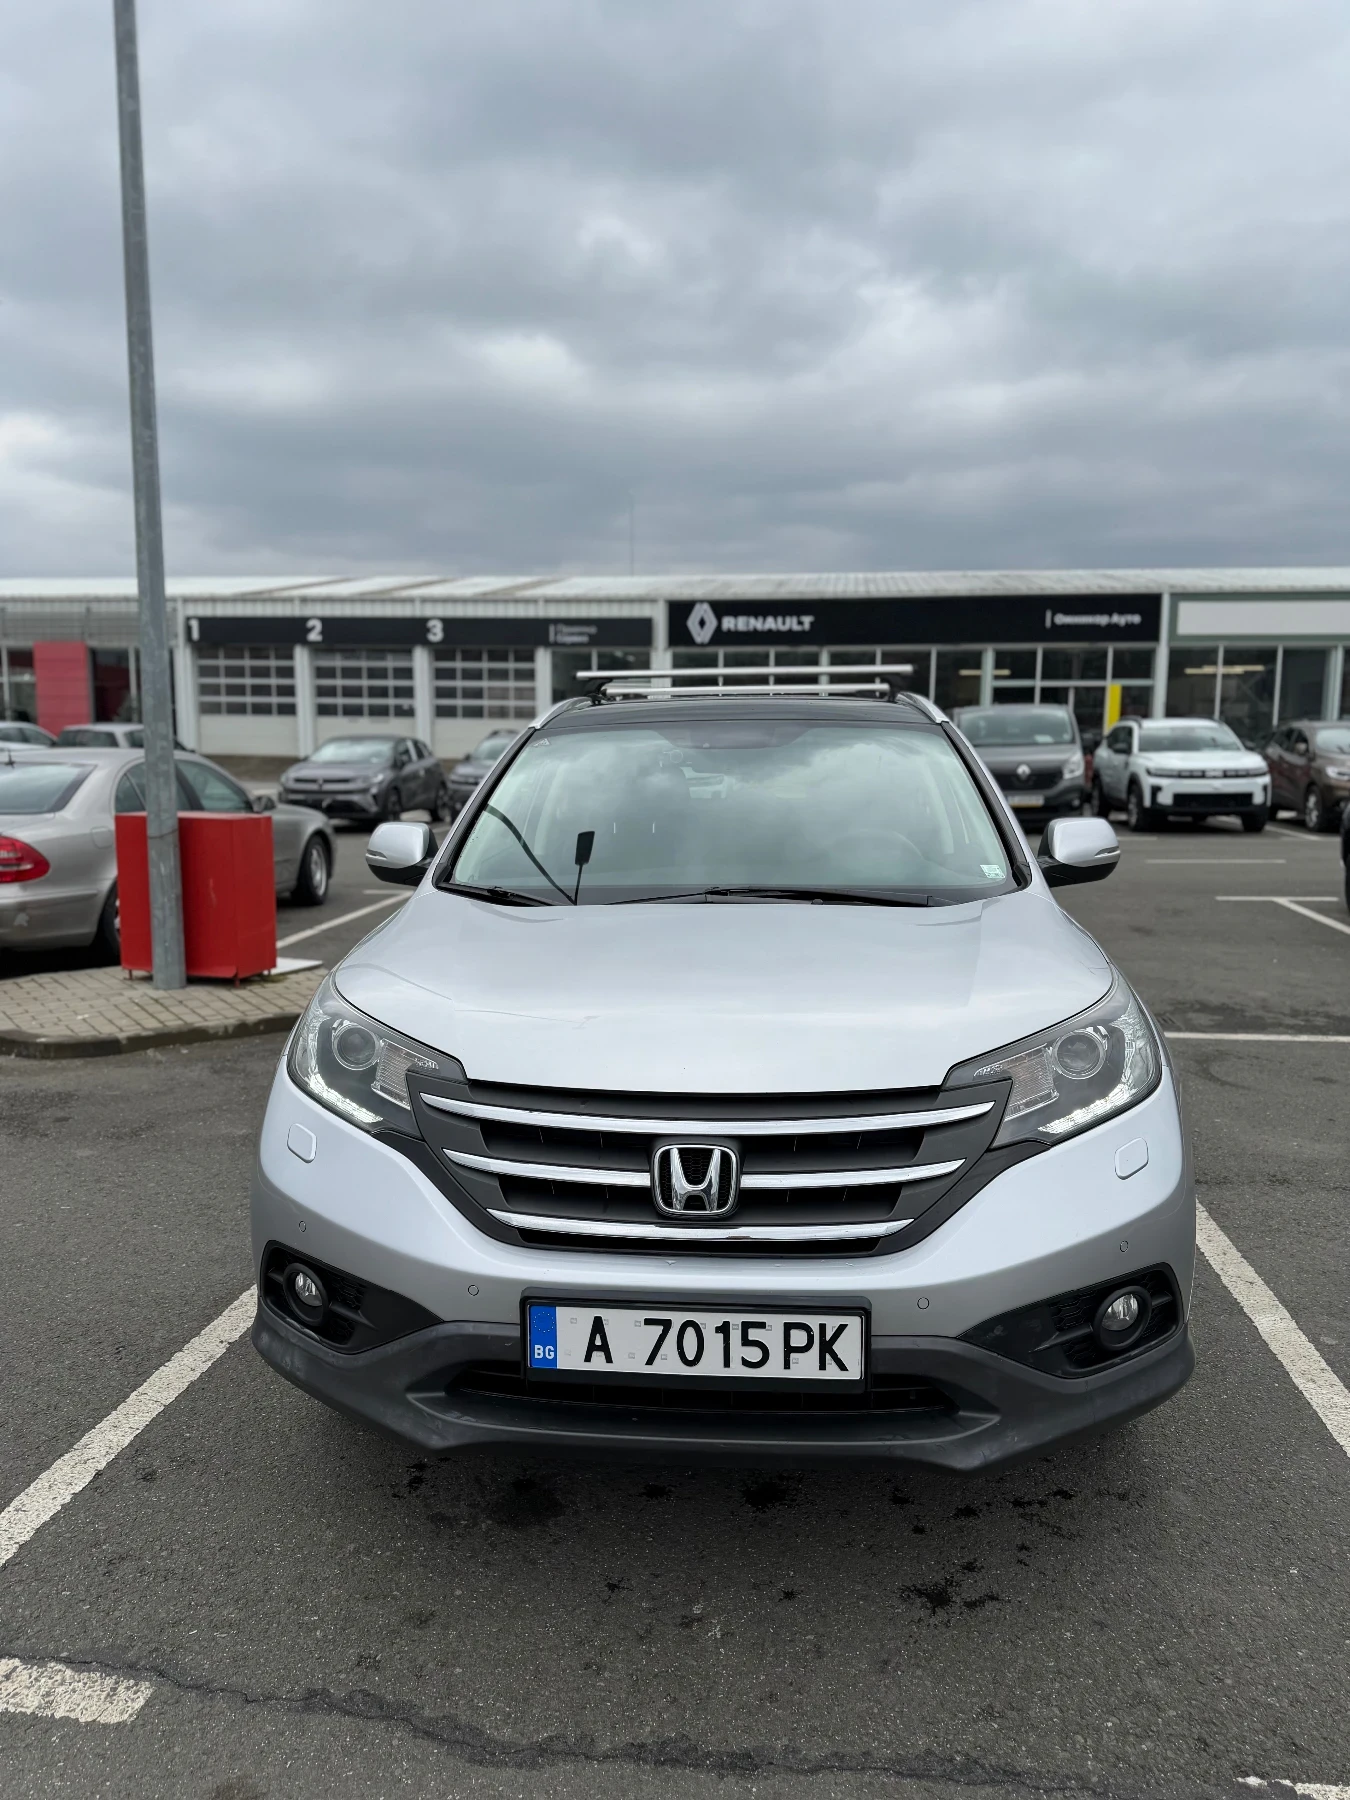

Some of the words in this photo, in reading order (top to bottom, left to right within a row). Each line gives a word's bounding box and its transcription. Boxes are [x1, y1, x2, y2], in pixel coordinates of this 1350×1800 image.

[188, 618, 200, 641] 1
[306, 618, 323, 642] 2
[426, 618, 444, 642] 3
[721, 615, 815, 632] RENAULT
[583, 1315, 614, 1364] A
[534, 1344, 555, 1360] BG
